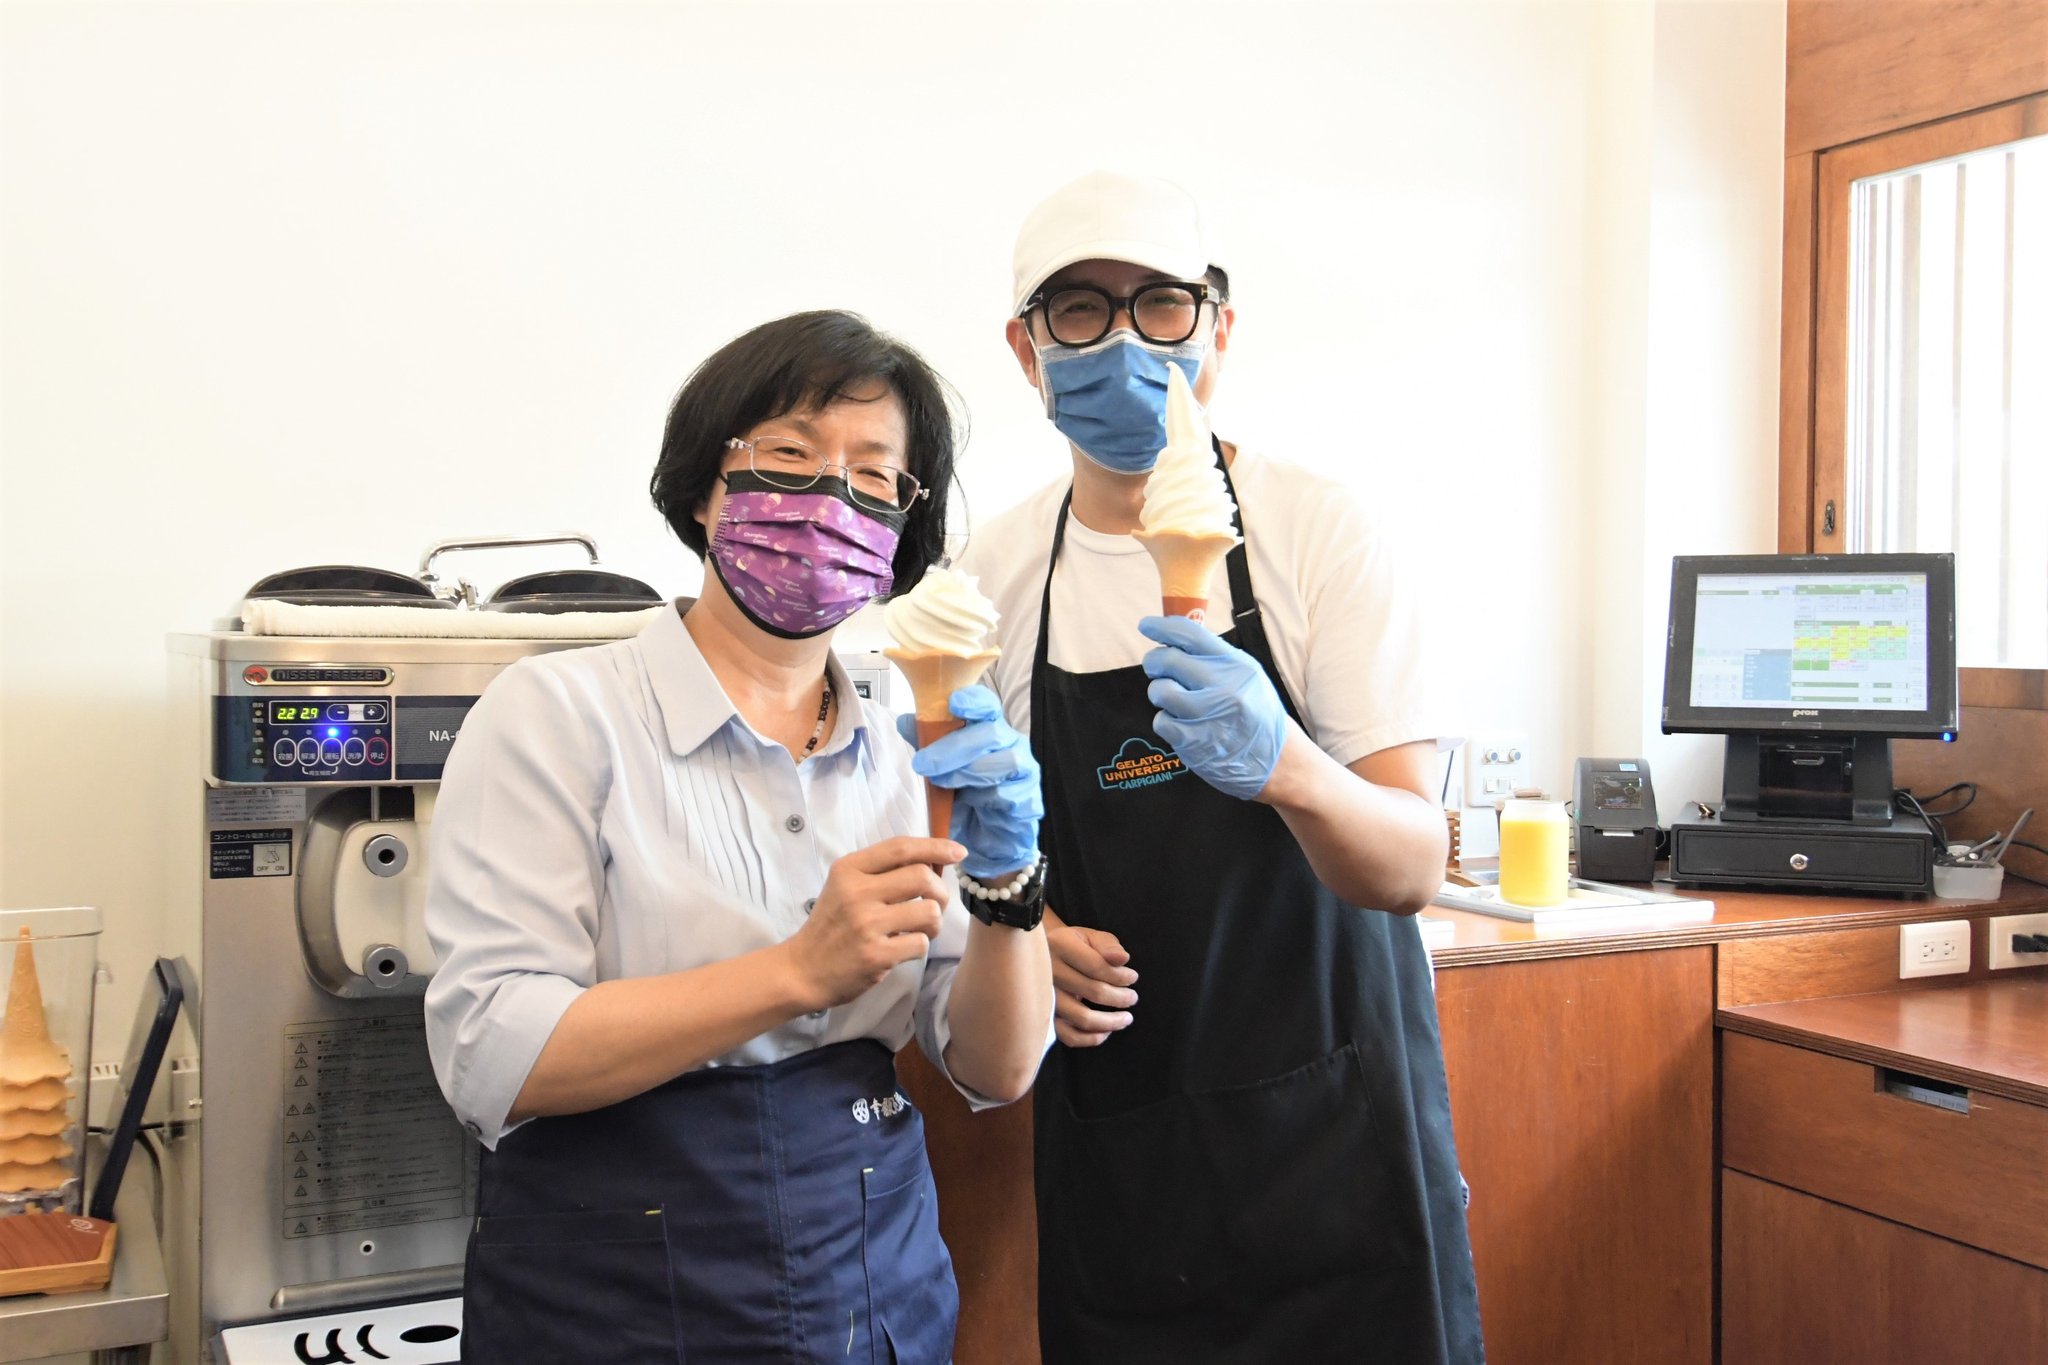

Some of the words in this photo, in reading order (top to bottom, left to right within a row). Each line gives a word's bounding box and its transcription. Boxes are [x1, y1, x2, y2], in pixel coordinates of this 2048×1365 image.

[325, 670, 381, 680] FREEZER
[429, 730, 461, 742] NA-
[370, 752, 385, 760] 停止
[1116, 755, 1163, 769] GELATO
[1105, 759, 1180, 781] UNIVERSITY
[1119, 772, 1173, 789] CARPIGIANI
